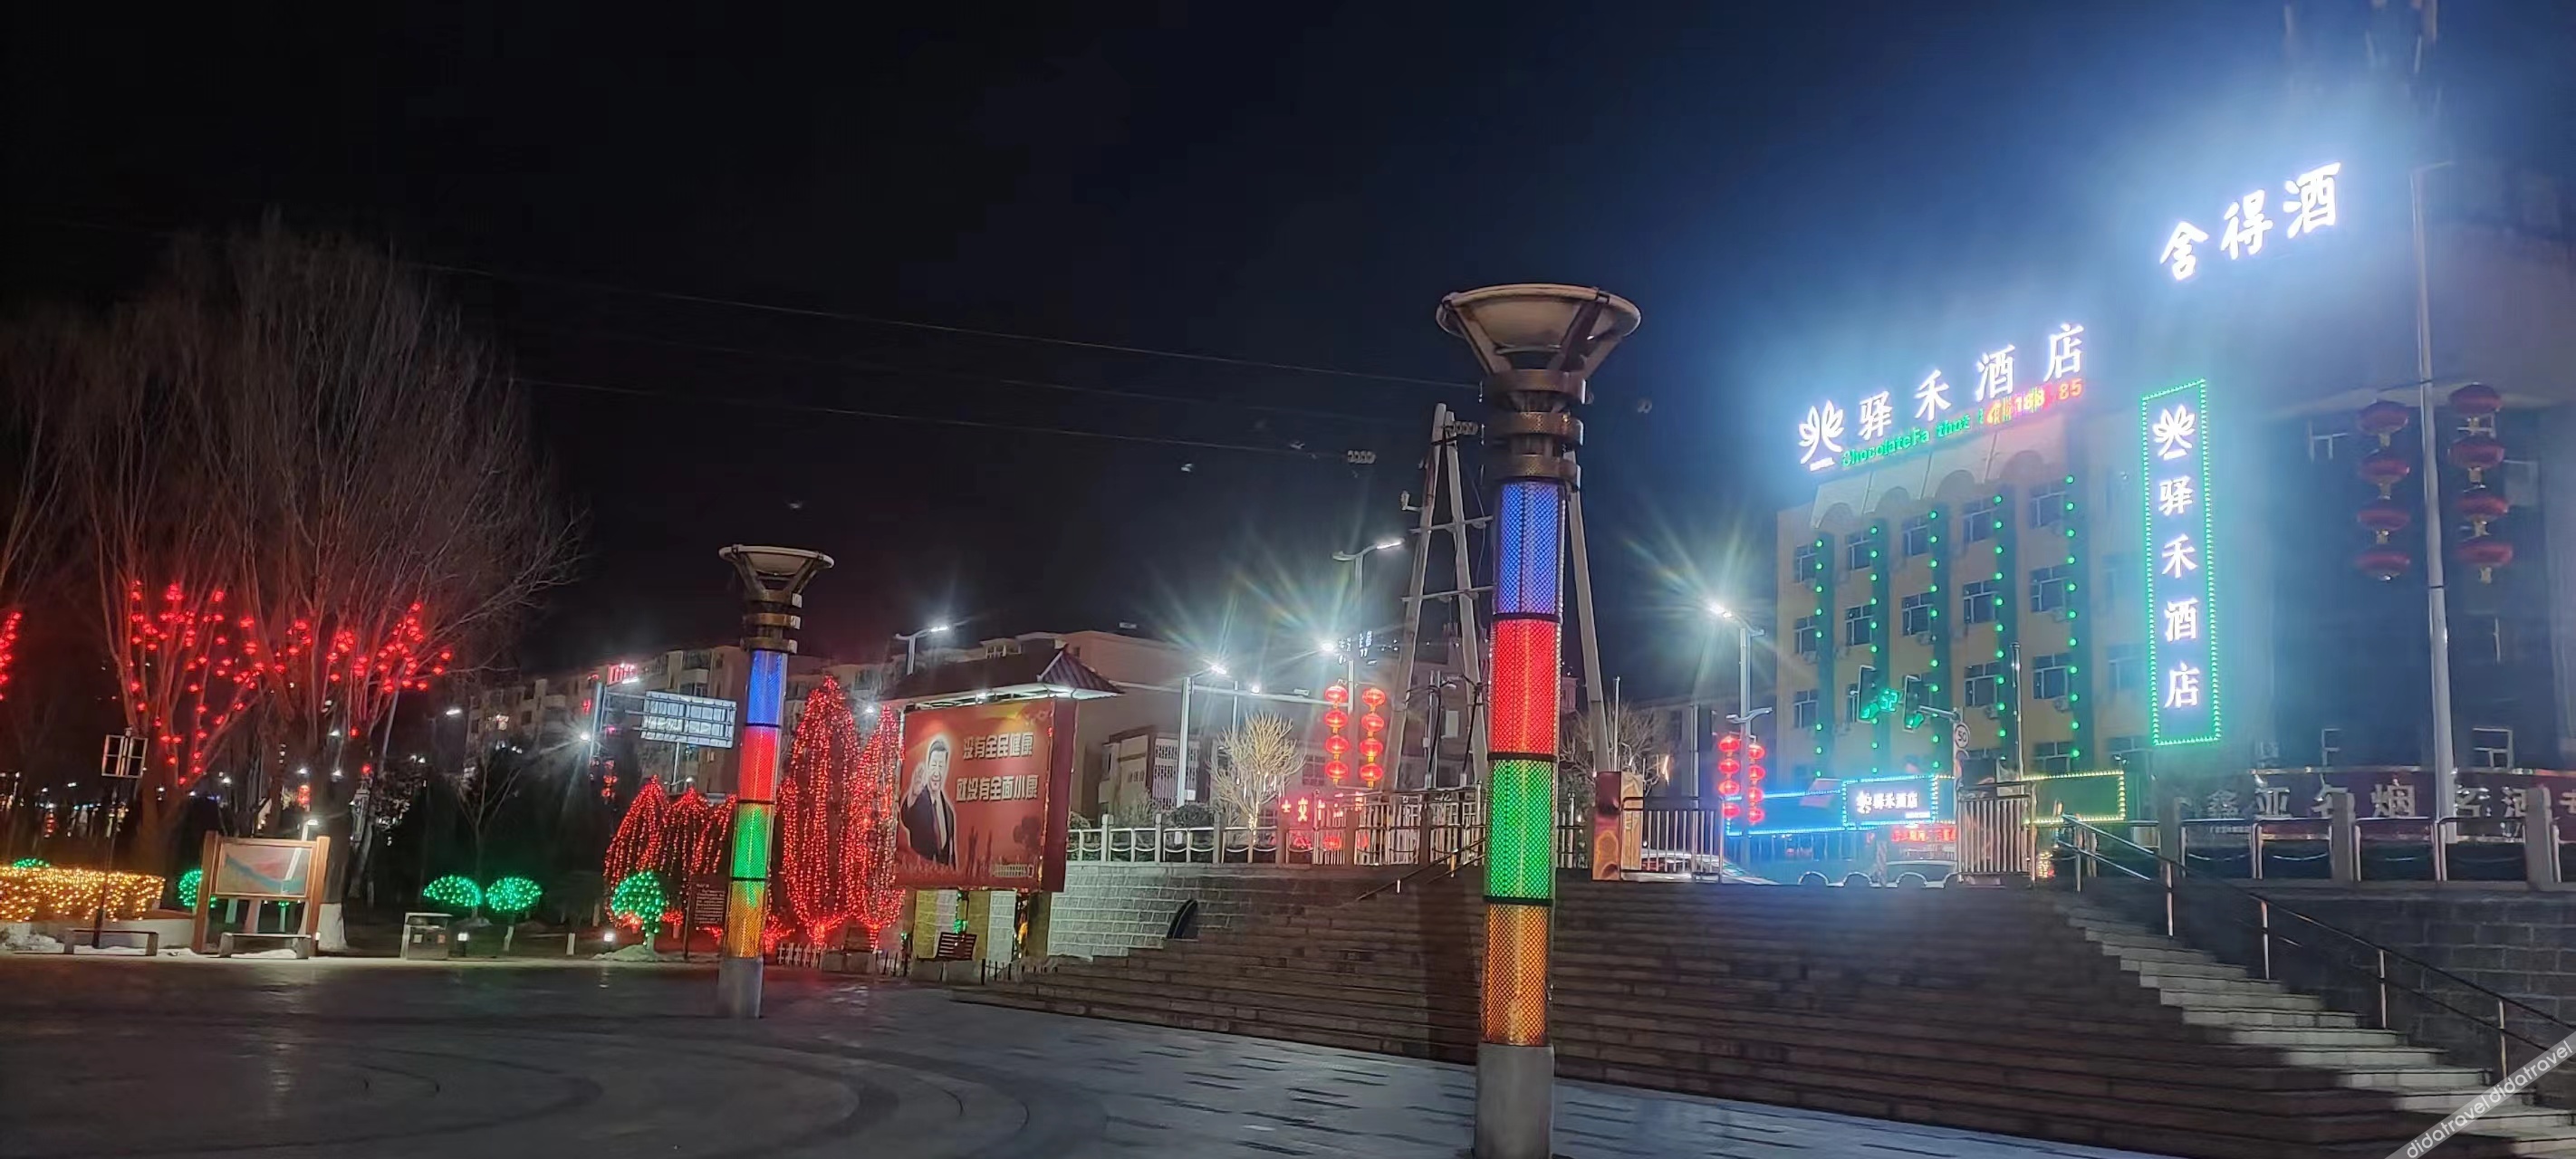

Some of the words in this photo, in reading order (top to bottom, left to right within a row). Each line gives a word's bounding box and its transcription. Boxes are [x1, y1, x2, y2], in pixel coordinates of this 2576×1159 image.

[2159, 160, 2341, 282] 舍得酒
[1859, 321, 2085, 441] 驿禾酒店
[2158, 474, 2202, 710] 驿禾酒店
[963, 732, 1033, 760] 没有全民健康
[1957, 730, 1967, 742] 50
[956, 774, 1039, 801] 就没有全面小康
